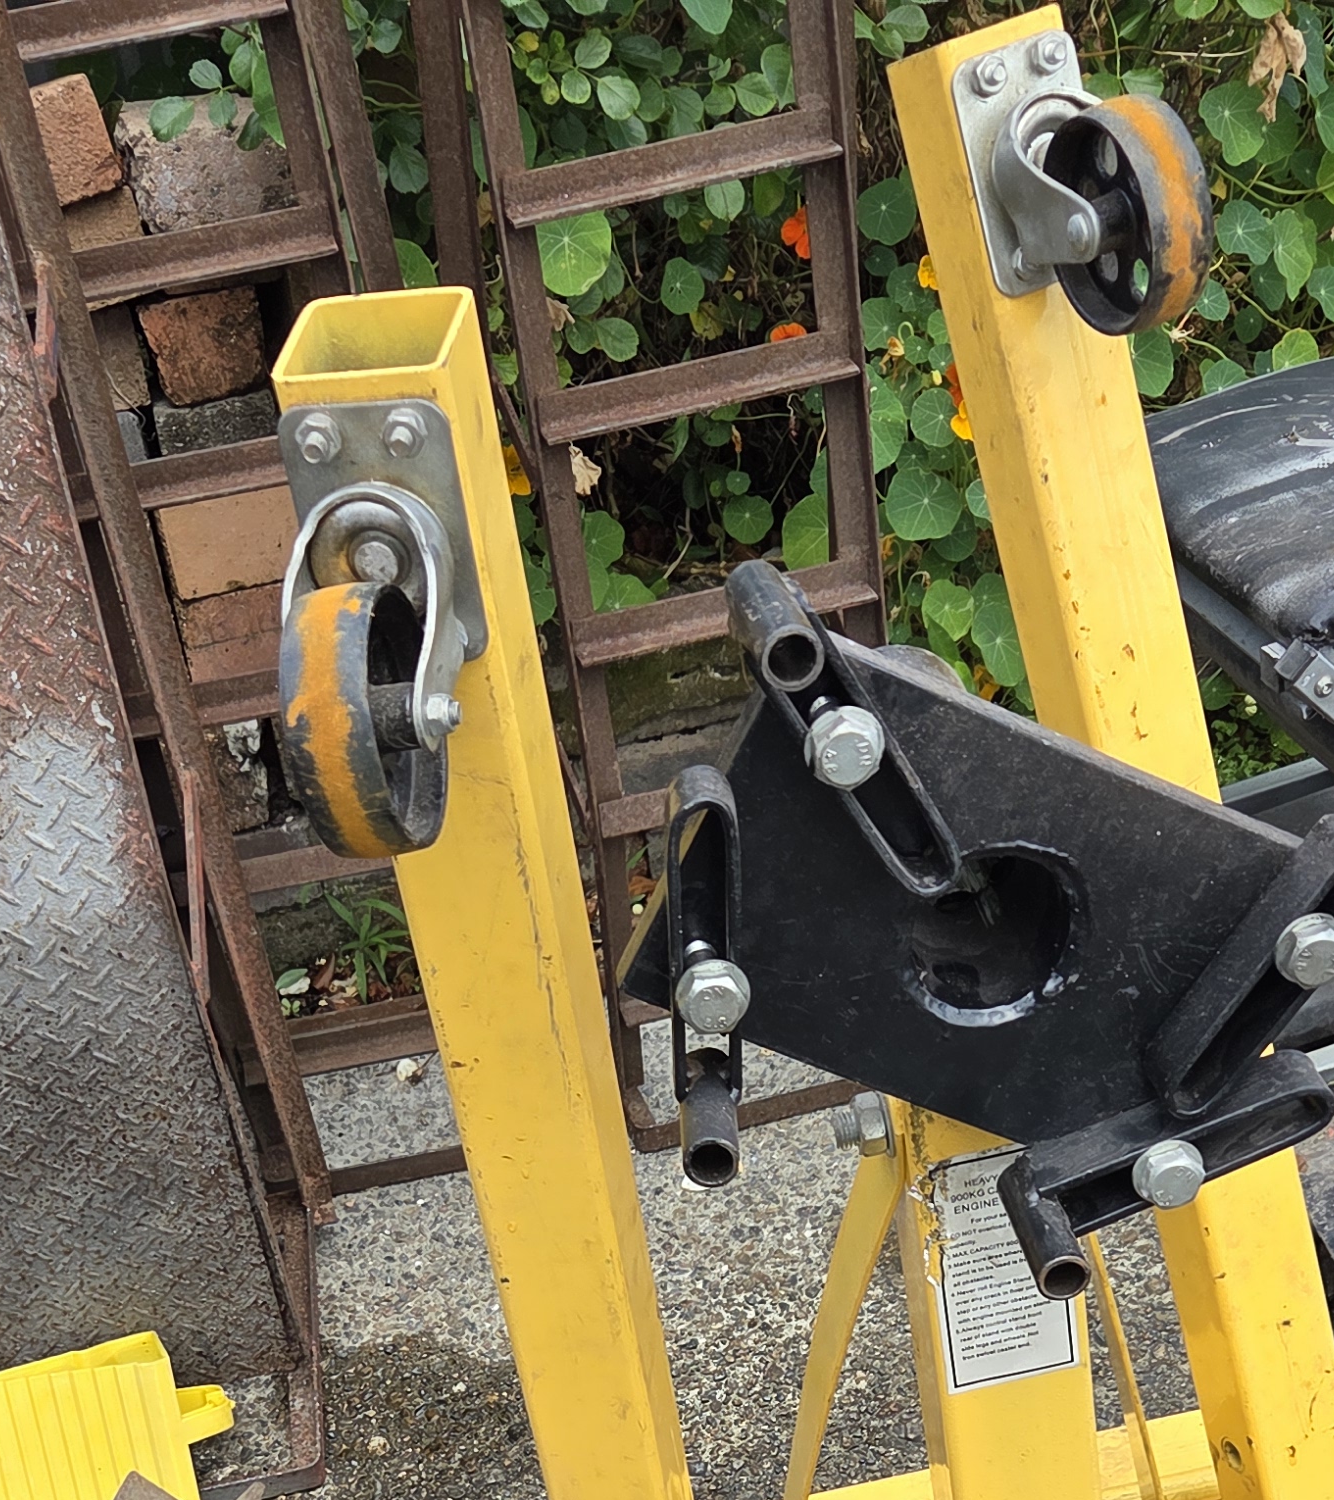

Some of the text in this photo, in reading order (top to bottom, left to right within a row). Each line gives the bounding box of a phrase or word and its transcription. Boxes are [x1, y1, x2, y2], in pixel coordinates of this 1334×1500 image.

[964, 1174, 998, 1187] HEAVY
[954, 1197, 999, 1215] ENGINE
[970, 1240, 1005, 1255] CAPACITY
